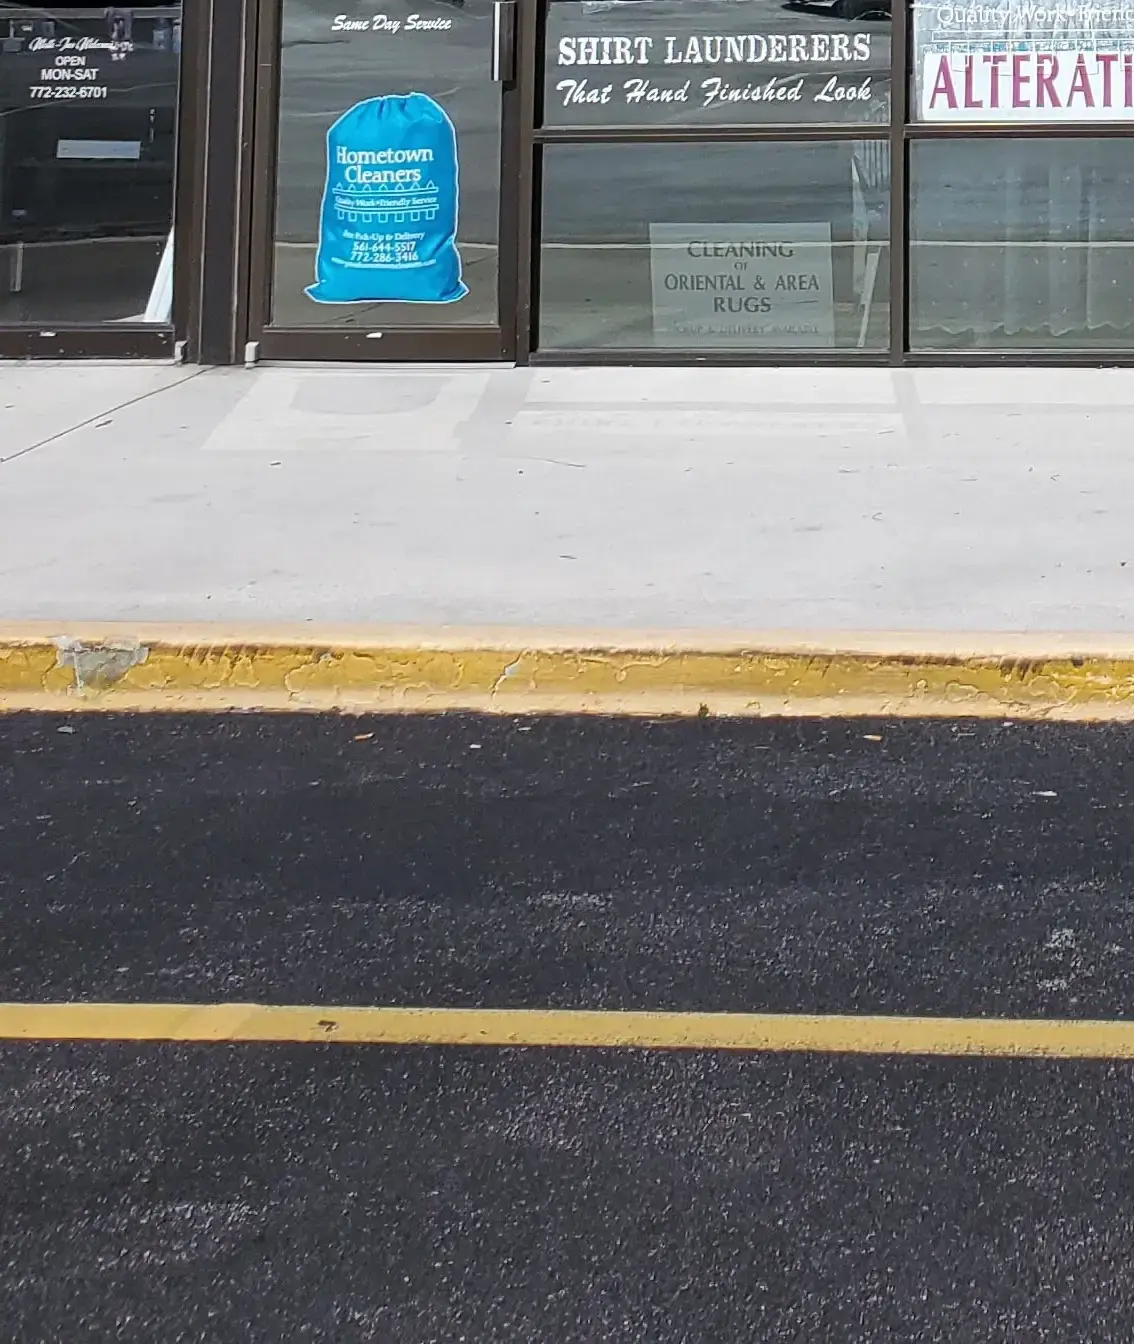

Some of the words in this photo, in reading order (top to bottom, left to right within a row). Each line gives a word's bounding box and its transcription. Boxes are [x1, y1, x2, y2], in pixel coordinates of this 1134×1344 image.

[332, 14, 369, 32] Same
[372, 14, 400, 34] Day
[404, 14, 451, 32] Service
[936, 6, 1008, 27] Quality
[557, 36, 653, 66] SHIRT
[664, 33, 871, 64] LAUNDERERS
[55, 56, 86, 66] OPEN
[41, 68, 100, 81] MON-SAT
[556, 79, 613, 106] That
[623, 78, 689, 104] Hand
[701, 76, 802, 106] Finished
[813, 75, 872, 102] Look
[336, 146, 434, 164] Hometown
[344, 165, 422, 183] Cleaners
[687, 241, 794, 258] CLEANING
[664, 274, 745, 291] ORIENTAL
[753, 274, 766, 291] &
[775, 274, 819, 291] AREA
[713, 296, 772, 313] RUGS
